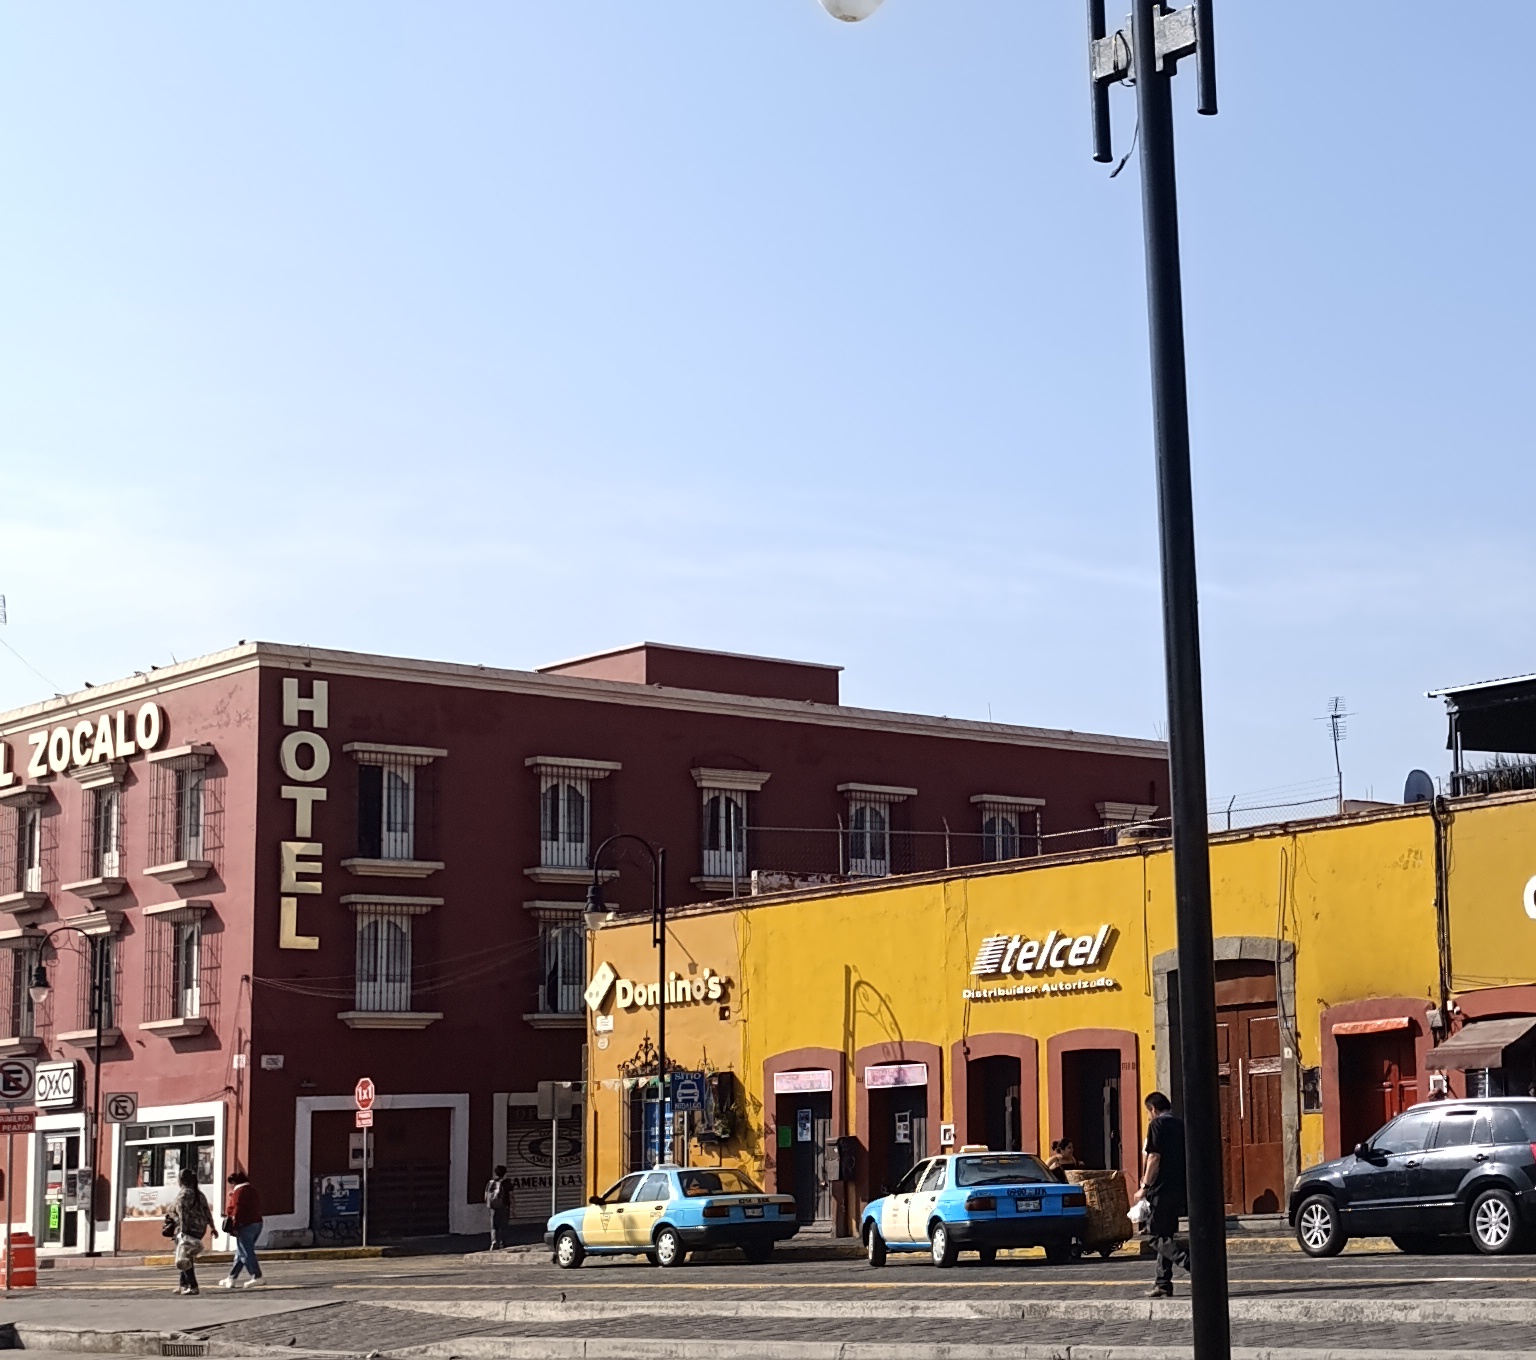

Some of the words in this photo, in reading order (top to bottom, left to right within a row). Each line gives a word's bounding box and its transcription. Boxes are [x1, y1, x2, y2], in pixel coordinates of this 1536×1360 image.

[28, 702, 160, 778] ZOCALO
[280, 678, 330, 950] HOTEL
[1000, 923, 1111, 974] telcel
[616, 967, 722, 1009] Domino's
[962, 984, 1038, 999] Distribuidor
[1041, 976, 1114, 992] Autorizado
[37, 1070, 72, 1099] OXXO
[674, 1072, 701, 1081] SITIO
